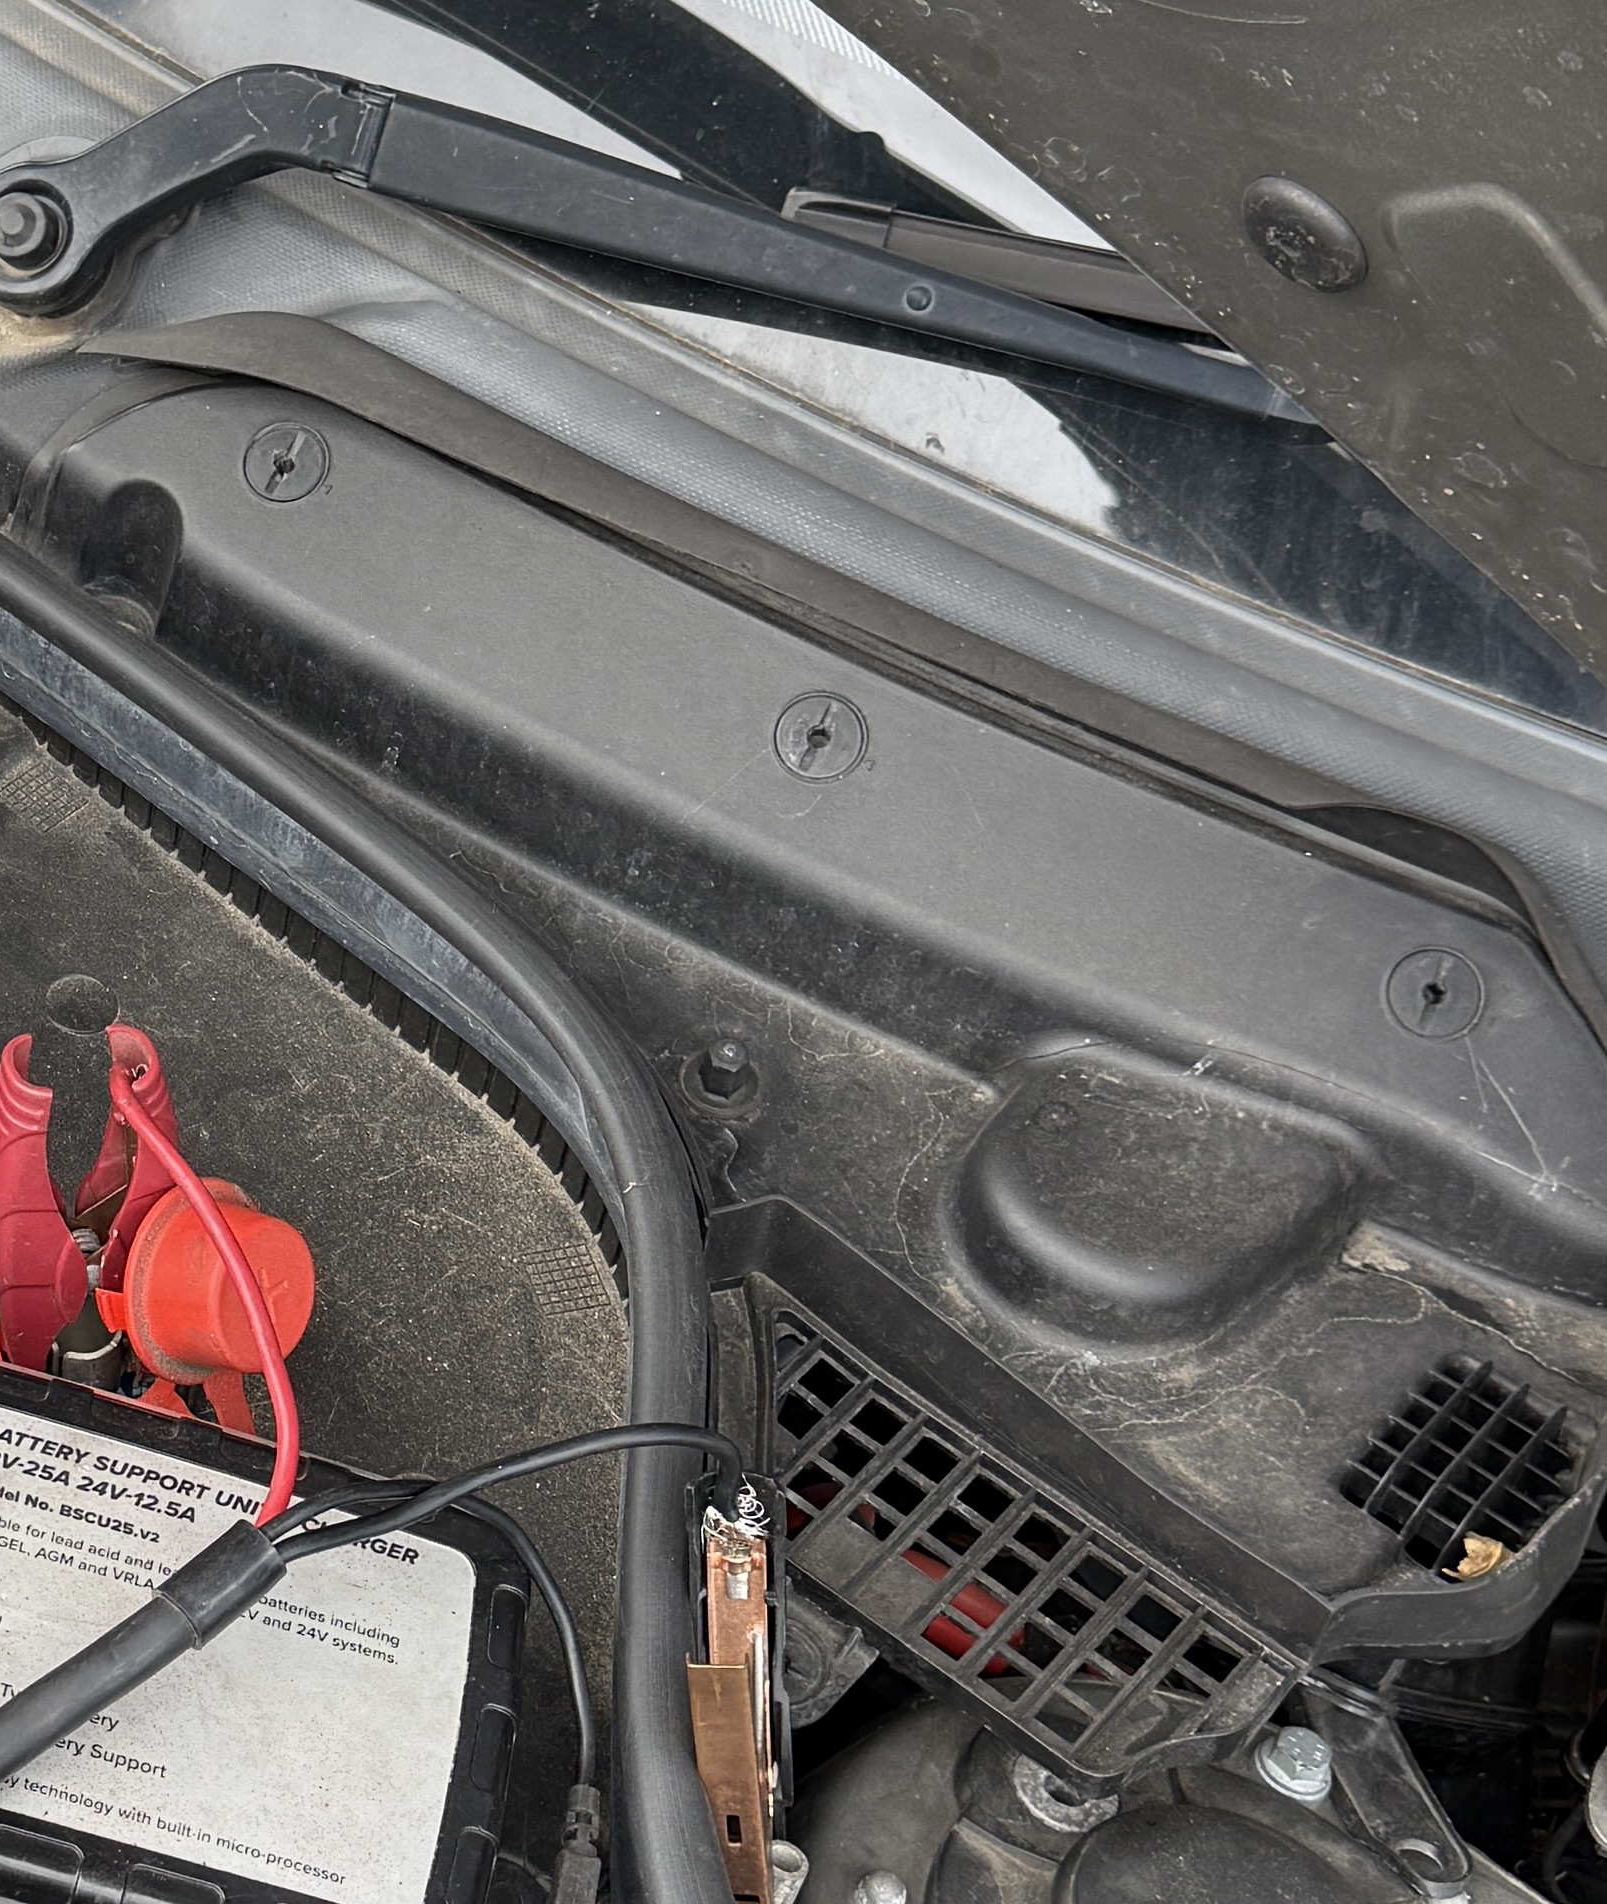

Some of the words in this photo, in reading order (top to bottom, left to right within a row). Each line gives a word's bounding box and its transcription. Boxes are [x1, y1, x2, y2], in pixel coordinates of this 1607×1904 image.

[76, 1476, 196, 1524] 24V-12.5A
[94, 1455, 211, 1500] SUPPORT
[215, 1490, 265, 1516] UNI
[24, 1493, 54, 1513] No.
[59, 1504, 161, 1543] BSCU25.v2
[25, 1524, 48, 1540] for
[50, 1531, 84, 1551] lead
[87, 1541, 121, 1562] acid
[124, 1553, 154, 1571] and
[34, 1547, 75, 1567] AGM
[78, 1559, 108, 1577] and
[262, 1615, 293, 1632] and
[296, 1623, 330, 1642] 24V
[332, 1636, 399, 1665] systems.
[330, 1614, 400, 1649] including
[90, 1744, 167, 1779] Support
[23, 1777, 114, 1817] technology
[118, 1807, 152, 1825] with
[156, 1816, 212, 1844] built-in
[216, 1837, 347, 1885] micro-processor
